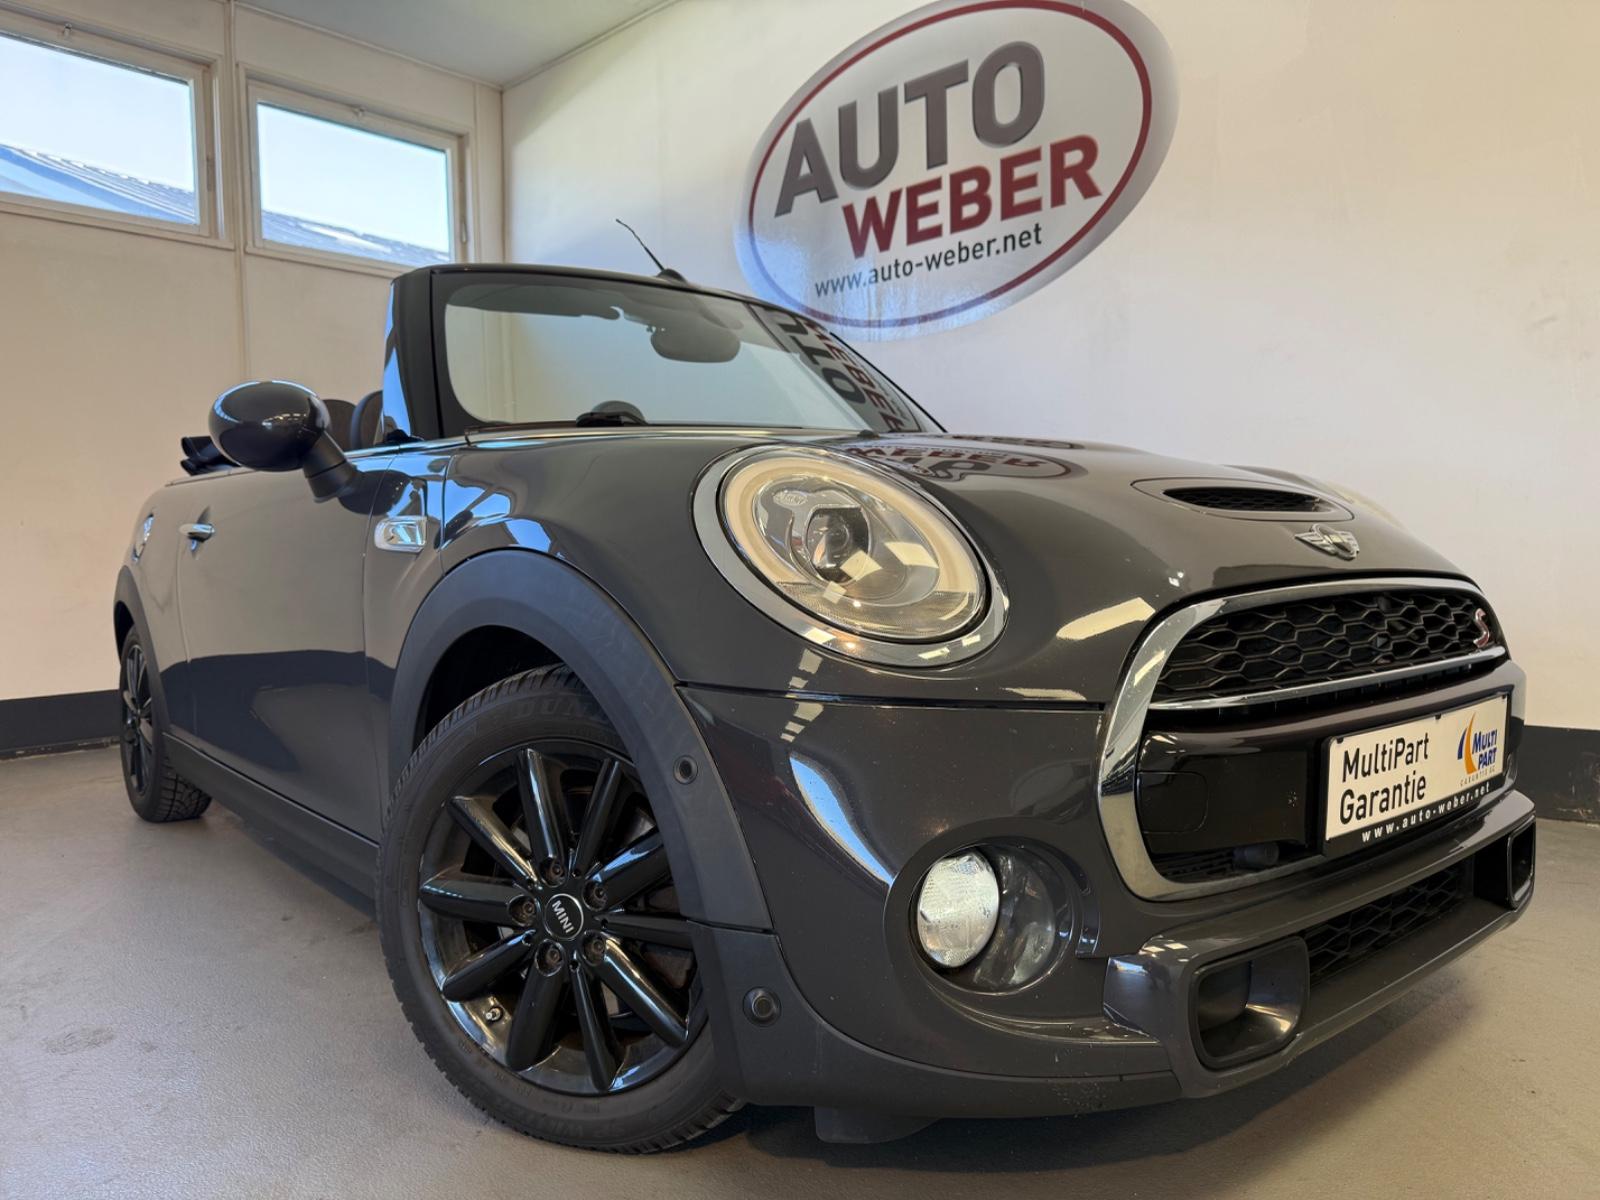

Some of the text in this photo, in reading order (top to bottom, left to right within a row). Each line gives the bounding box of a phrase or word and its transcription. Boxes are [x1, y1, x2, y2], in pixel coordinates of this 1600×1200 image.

[774, 40, 1045, 218] AUTO
[842, 134, 1103, 260] WEBER
[814, 223, 1043, 297] www.auto-weber.net
[1473, 608, 1490, 648] S
[1342, 733, 1430, 782] MultiPart
[1472, 729, 1497, 754] MULTI
[1478, 747, 1497, 770] PART
[1340, 770, 1427, 825] Garantie
[1362, 781, 1490, 842] www.auto-weber.net
[552, 900, 575, 934] MINI
